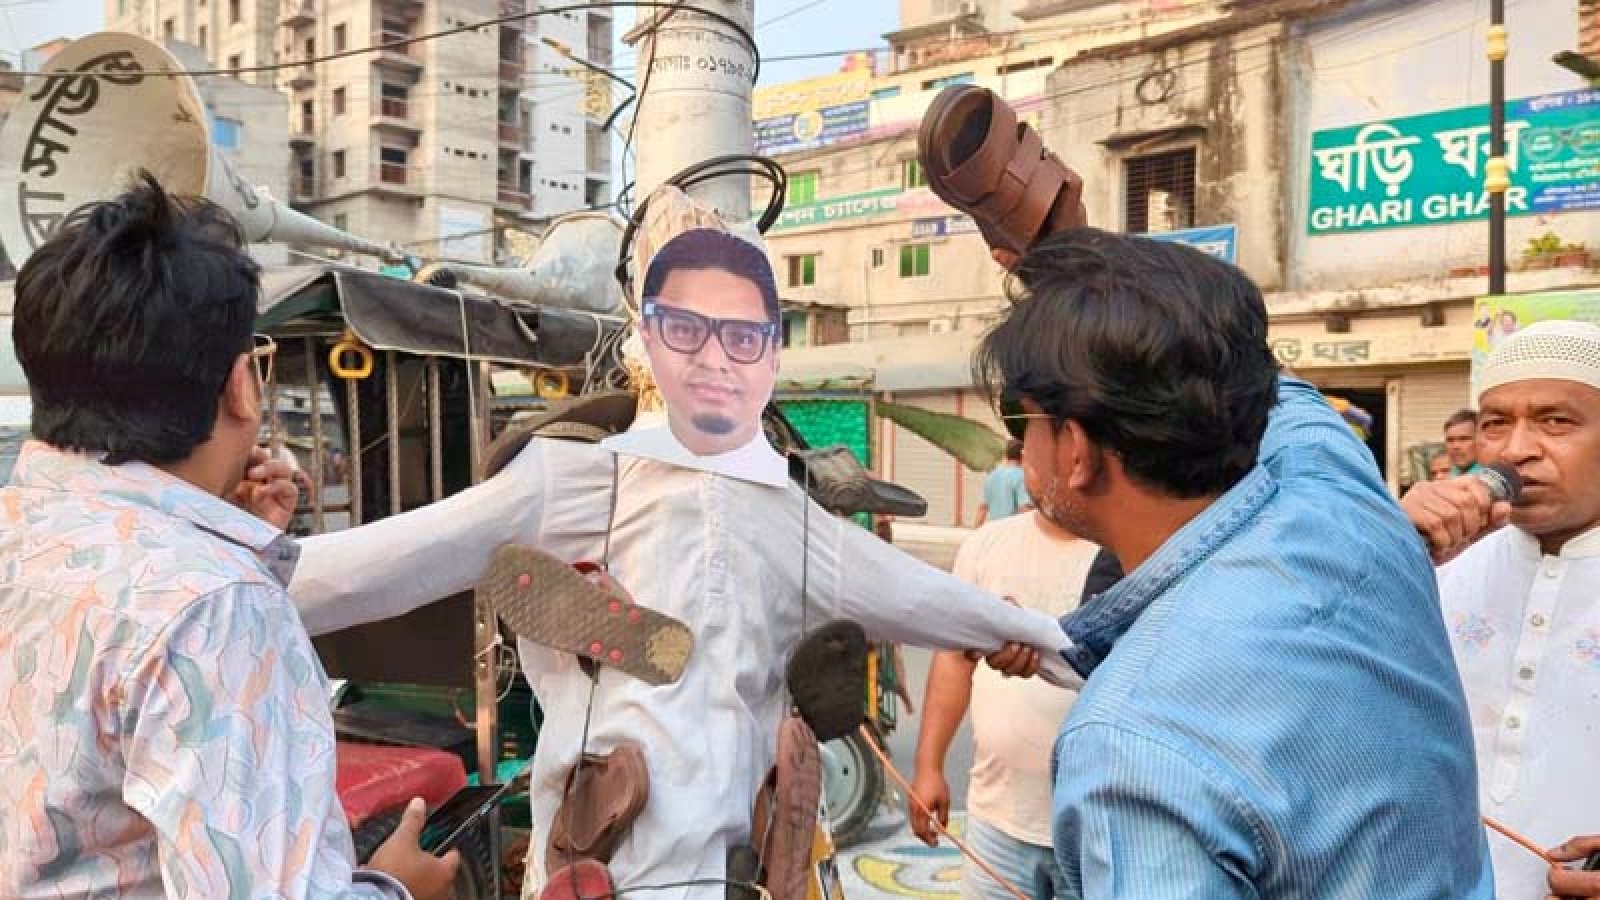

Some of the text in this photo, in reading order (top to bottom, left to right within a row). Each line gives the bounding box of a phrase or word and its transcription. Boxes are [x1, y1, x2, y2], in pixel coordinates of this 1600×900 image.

[1313, 123, 1422, 196] ঘড়ি
[1311, 199, 1412, 230] GHARI
[1422, 186, 1529, 219] GHAR
